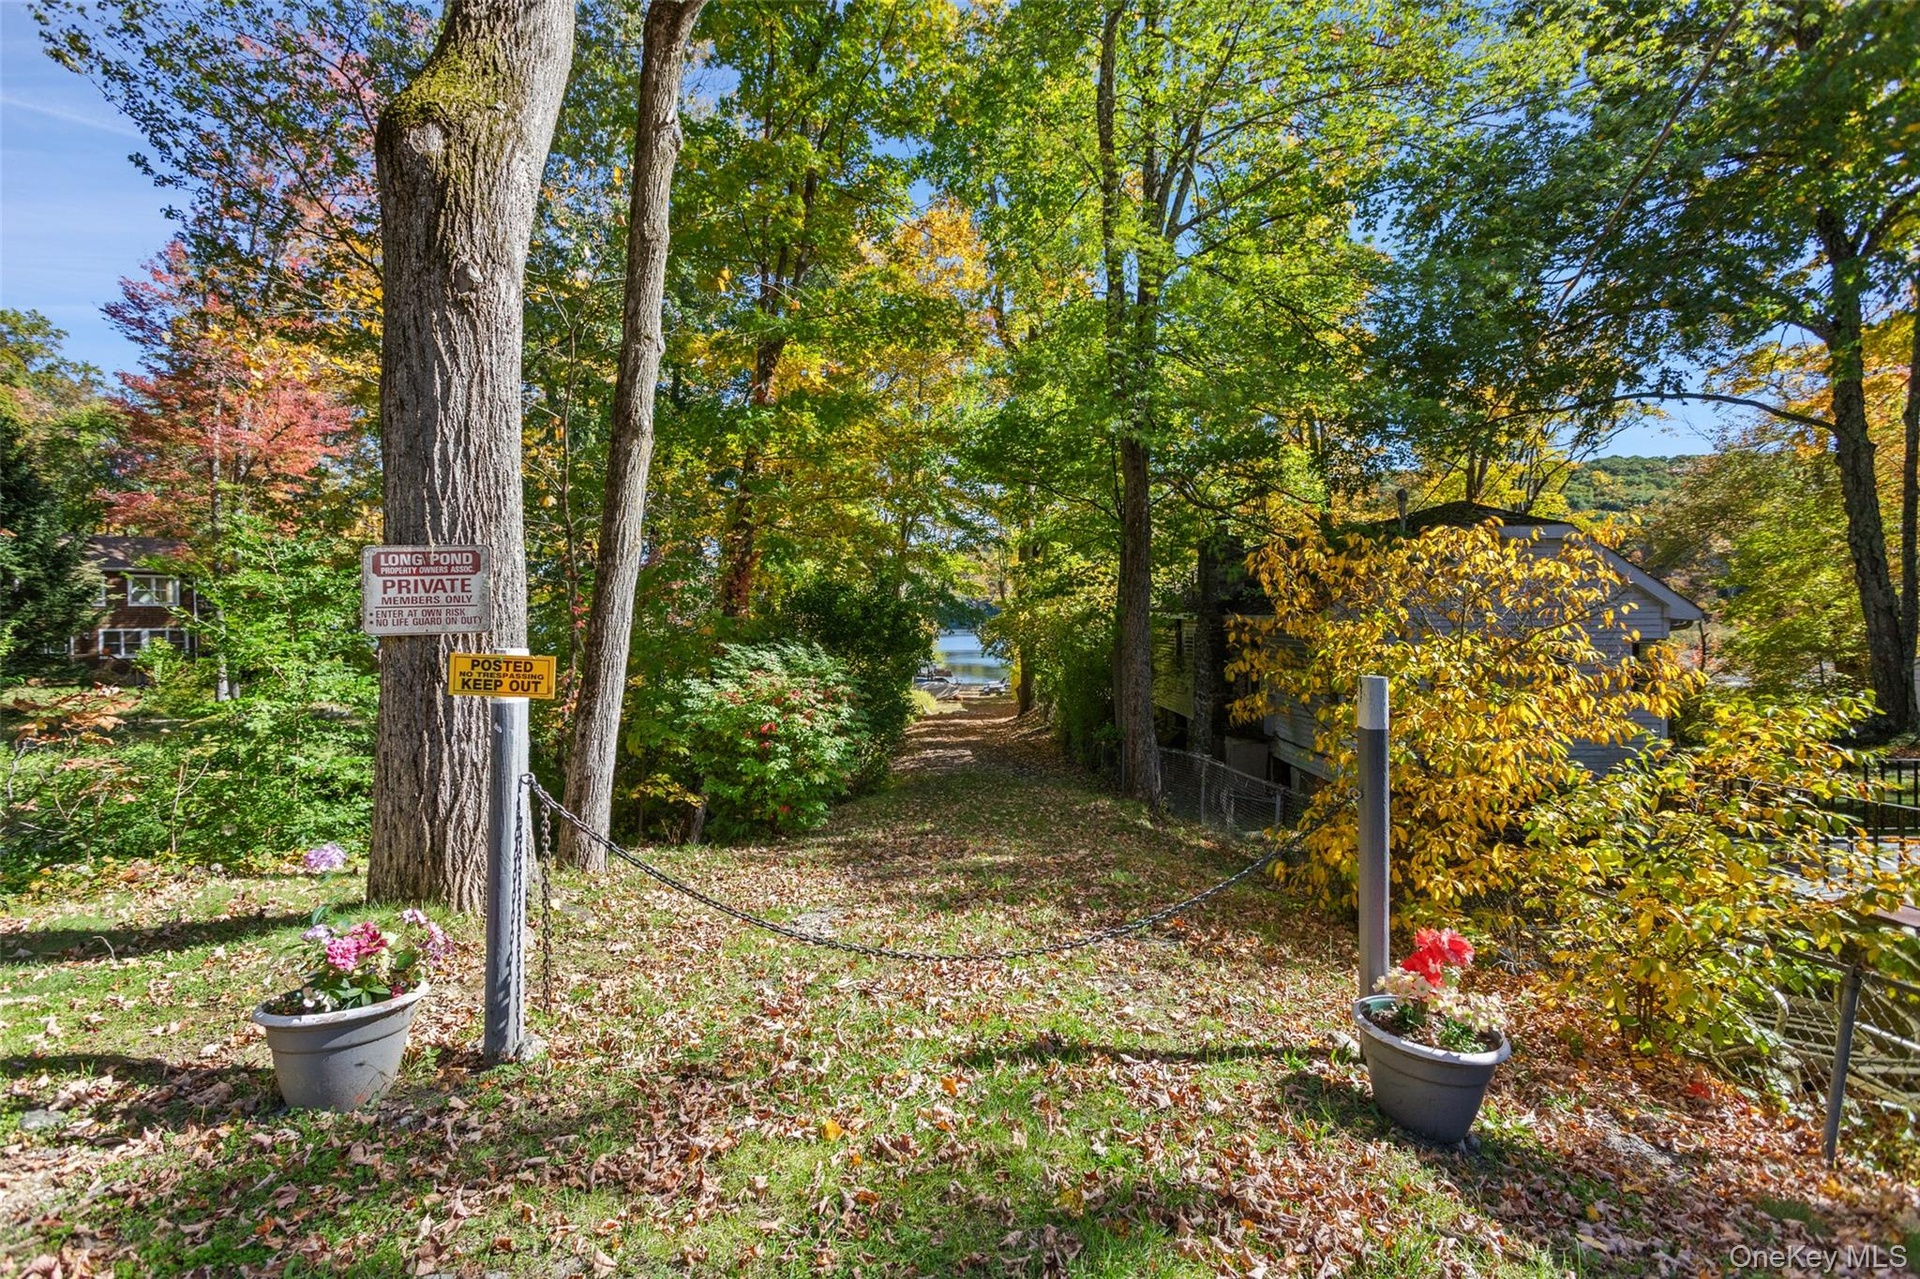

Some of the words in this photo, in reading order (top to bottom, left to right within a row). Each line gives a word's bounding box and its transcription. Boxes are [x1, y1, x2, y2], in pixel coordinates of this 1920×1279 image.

[381, 554, 423, 566] LONG
[430, 553, 473, 565] POND
[383, 578, 472, 594] PRIVATE
[381, 596, 440, 605] MEMBERS
[446, 595, 472, 603] ONLY
[376, 610, 403, 618] ENTER
[421, 609, 442, 617] OWN
[446, 608, 465, 616] RISK
[376, 619, 388, 627] NO
[392, 618, 409, 626] LIFE
[414, 617, 442, 626] GUARD
[446, 617, 457, 625] ON
[461, 616, 483, 624] DUTY
[471, 660, 533, 672] POSTED
[477, 672, 544, 680] TRESPASSING
[461, 679, 503, 691] KEEP
[509, 680, 541, 692] OUT
